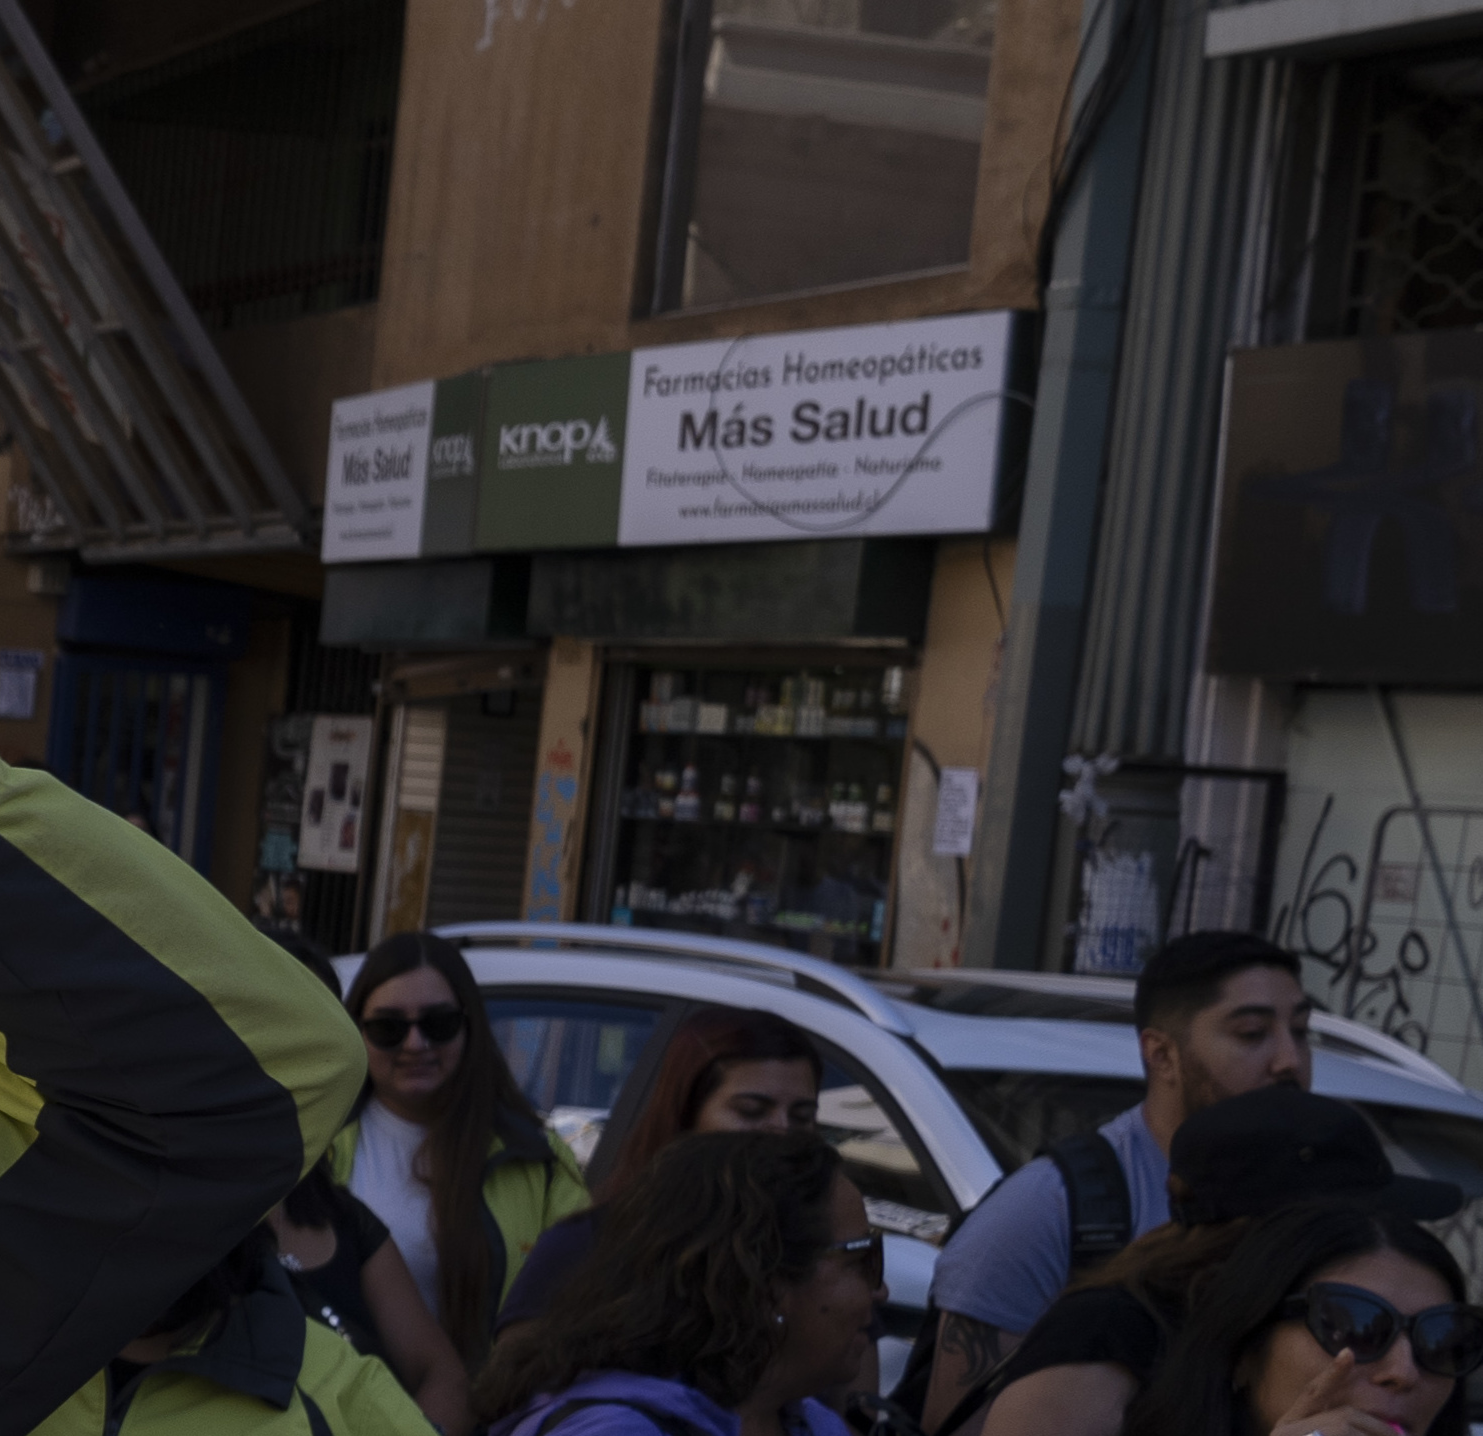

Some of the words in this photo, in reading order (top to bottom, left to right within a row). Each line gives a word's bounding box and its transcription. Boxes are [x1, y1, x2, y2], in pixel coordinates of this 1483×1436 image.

[642, 360, 772, 400] Farmacias
[781, 342, 984, 386] Homeopáticas
[677, 401, 774, 453] Más
[790, 391, 932, 445] Salud
[373, 440, 413, 482] Salud
